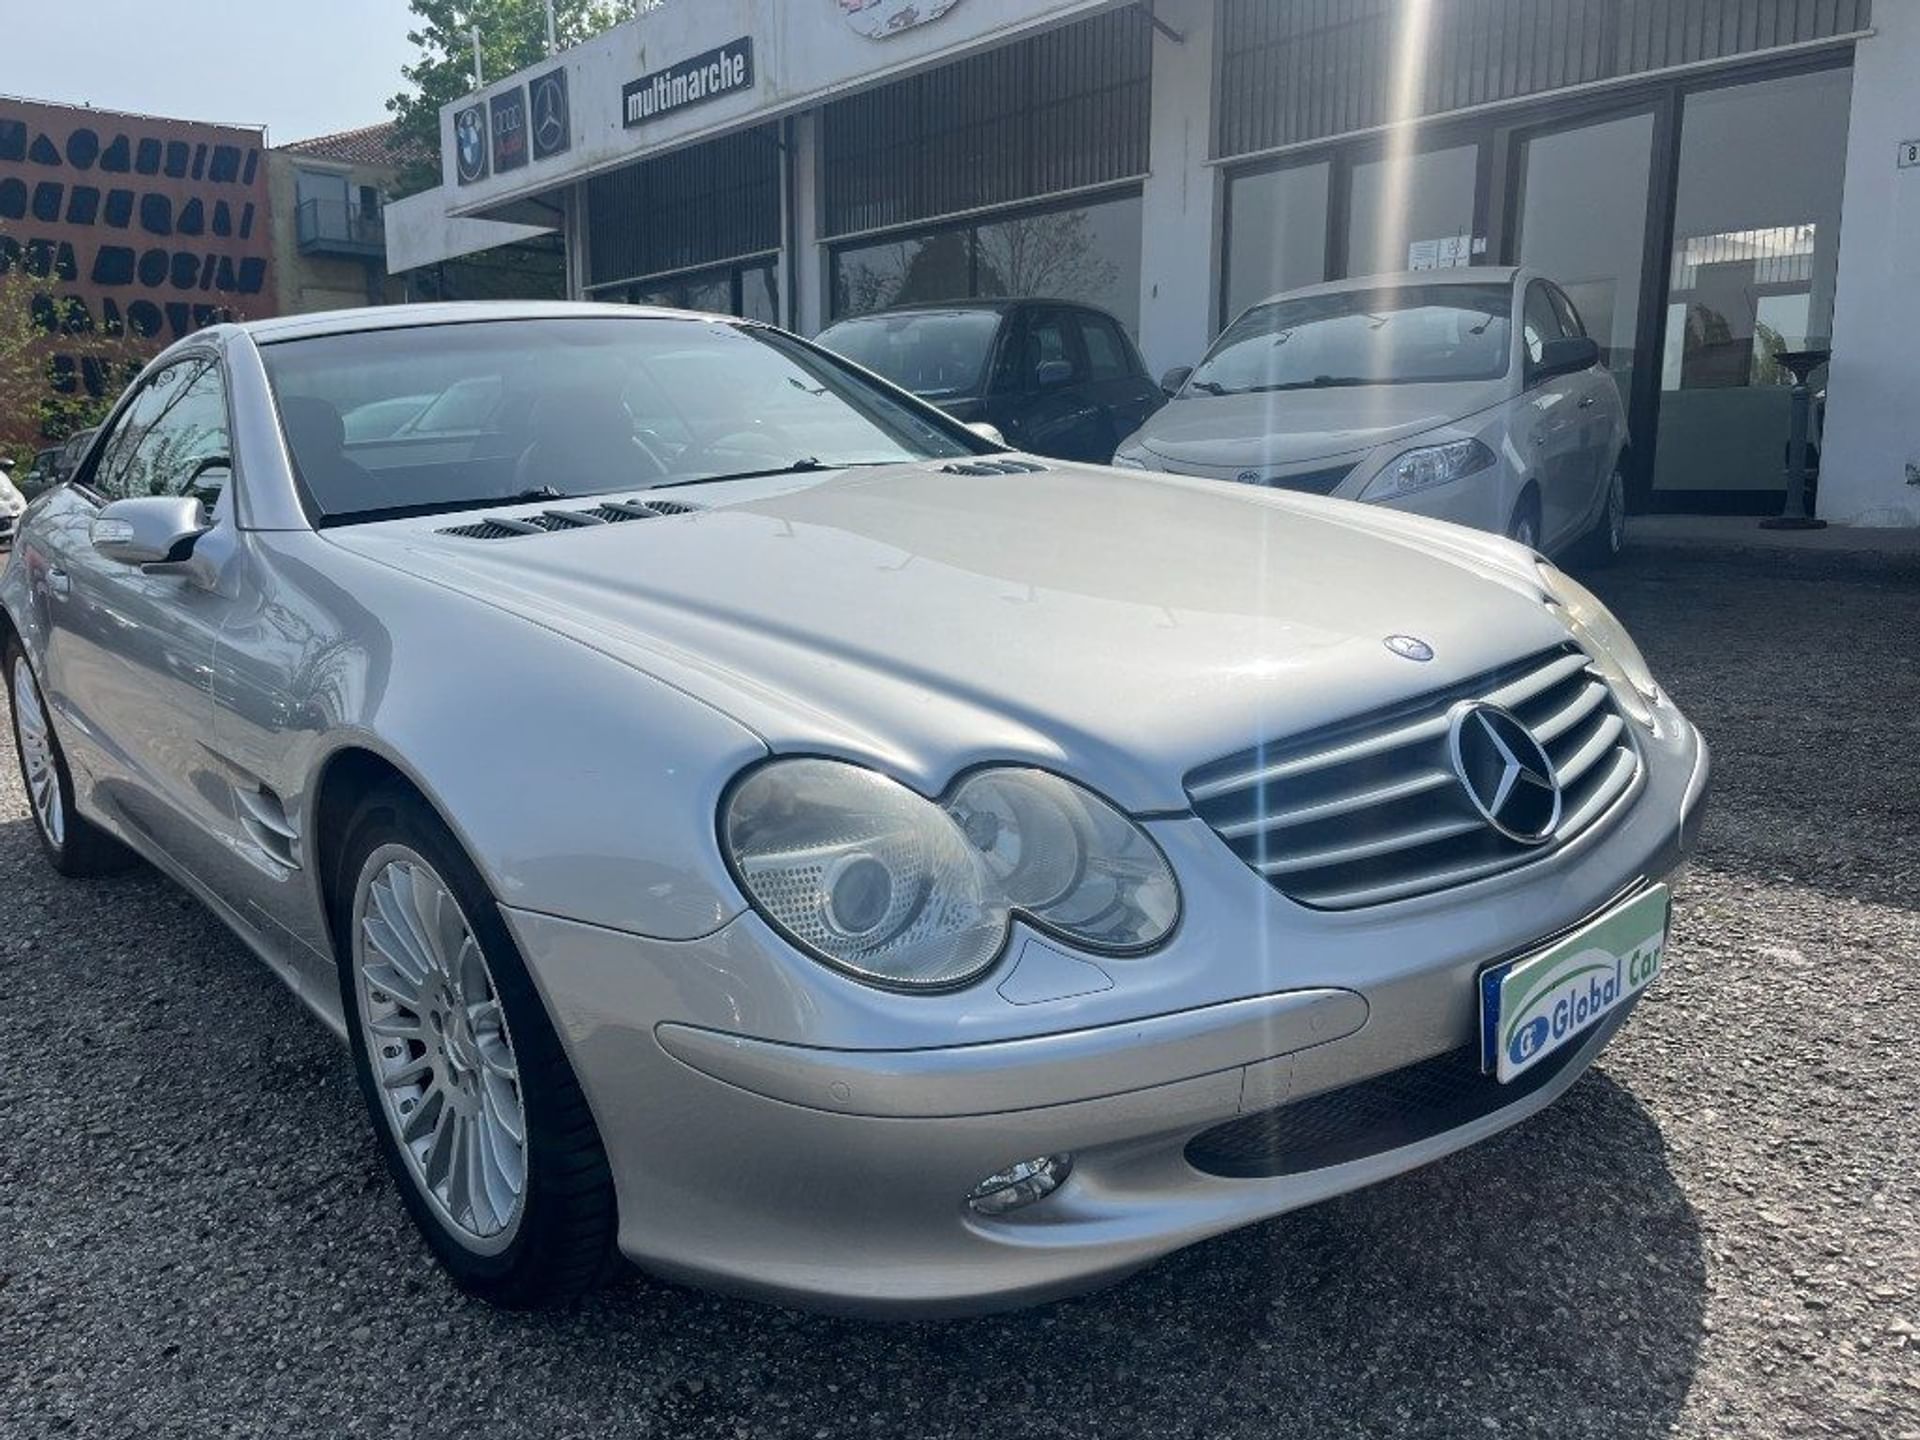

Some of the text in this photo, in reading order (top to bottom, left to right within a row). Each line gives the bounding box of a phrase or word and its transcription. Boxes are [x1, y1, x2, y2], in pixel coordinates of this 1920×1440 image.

[628, 50, 744, 122] multimarche
[1553, 959, 1621, 1039] Global
[1629, 947, 1660, 987] Car
